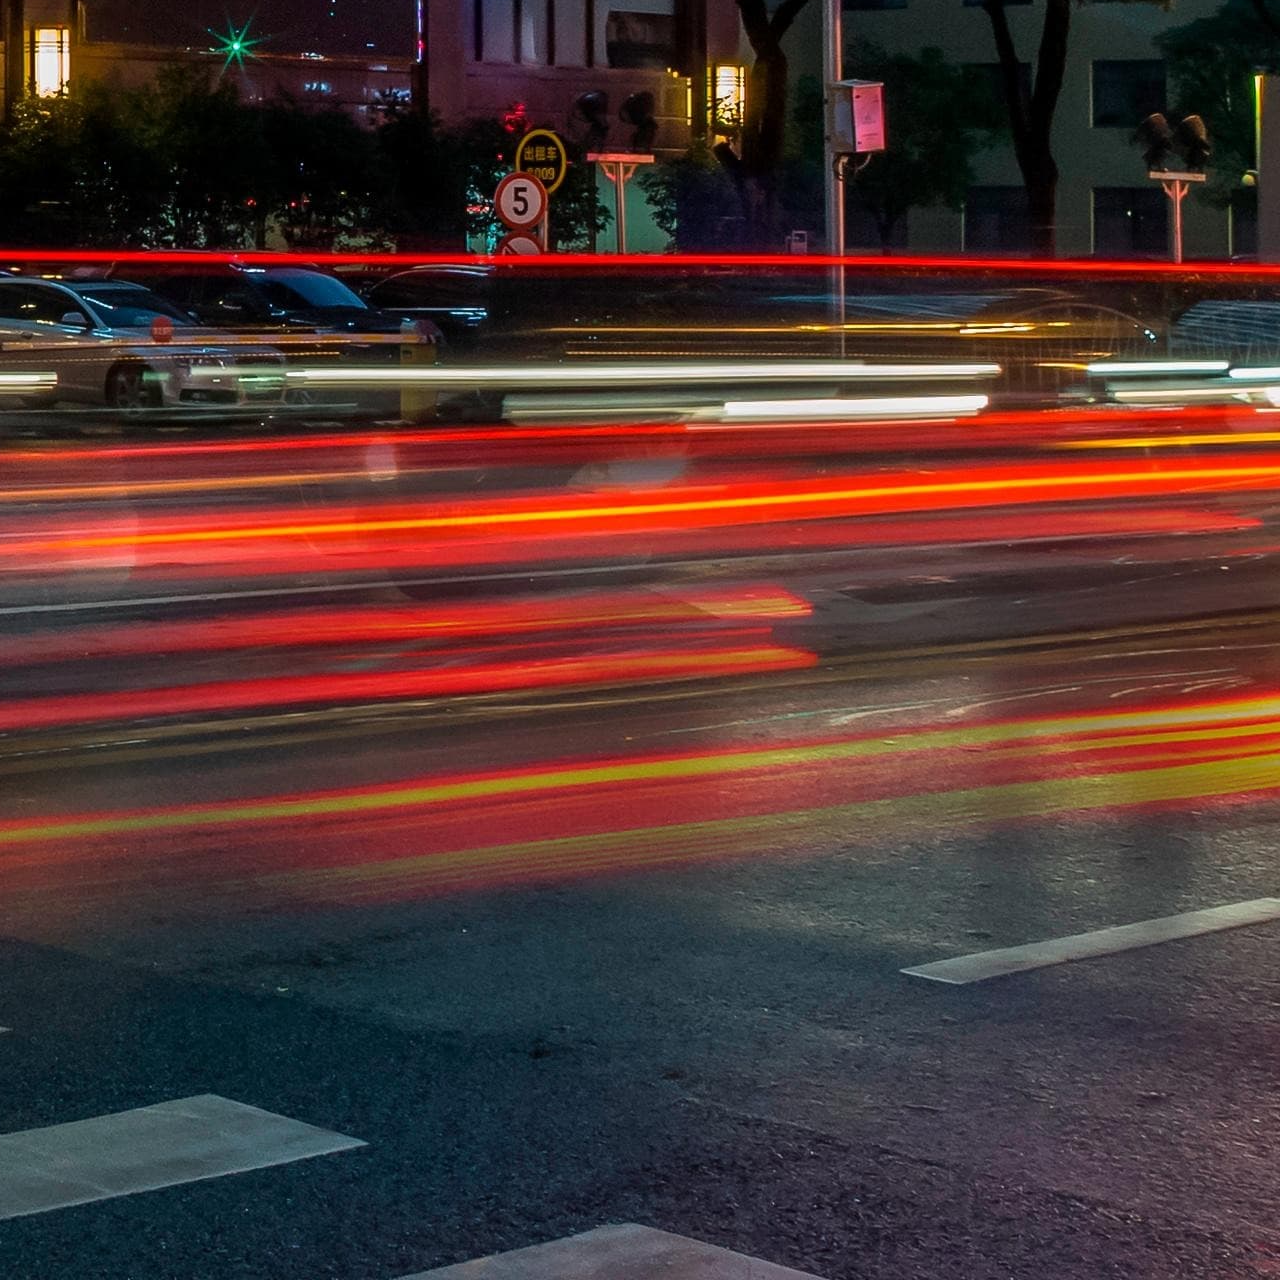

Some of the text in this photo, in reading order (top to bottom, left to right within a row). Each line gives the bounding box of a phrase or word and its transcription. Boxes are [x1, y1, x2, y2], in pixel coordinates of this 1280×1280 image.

[524, 146, 558, 160] 出租车
[512, 186, 529, 216] 5
